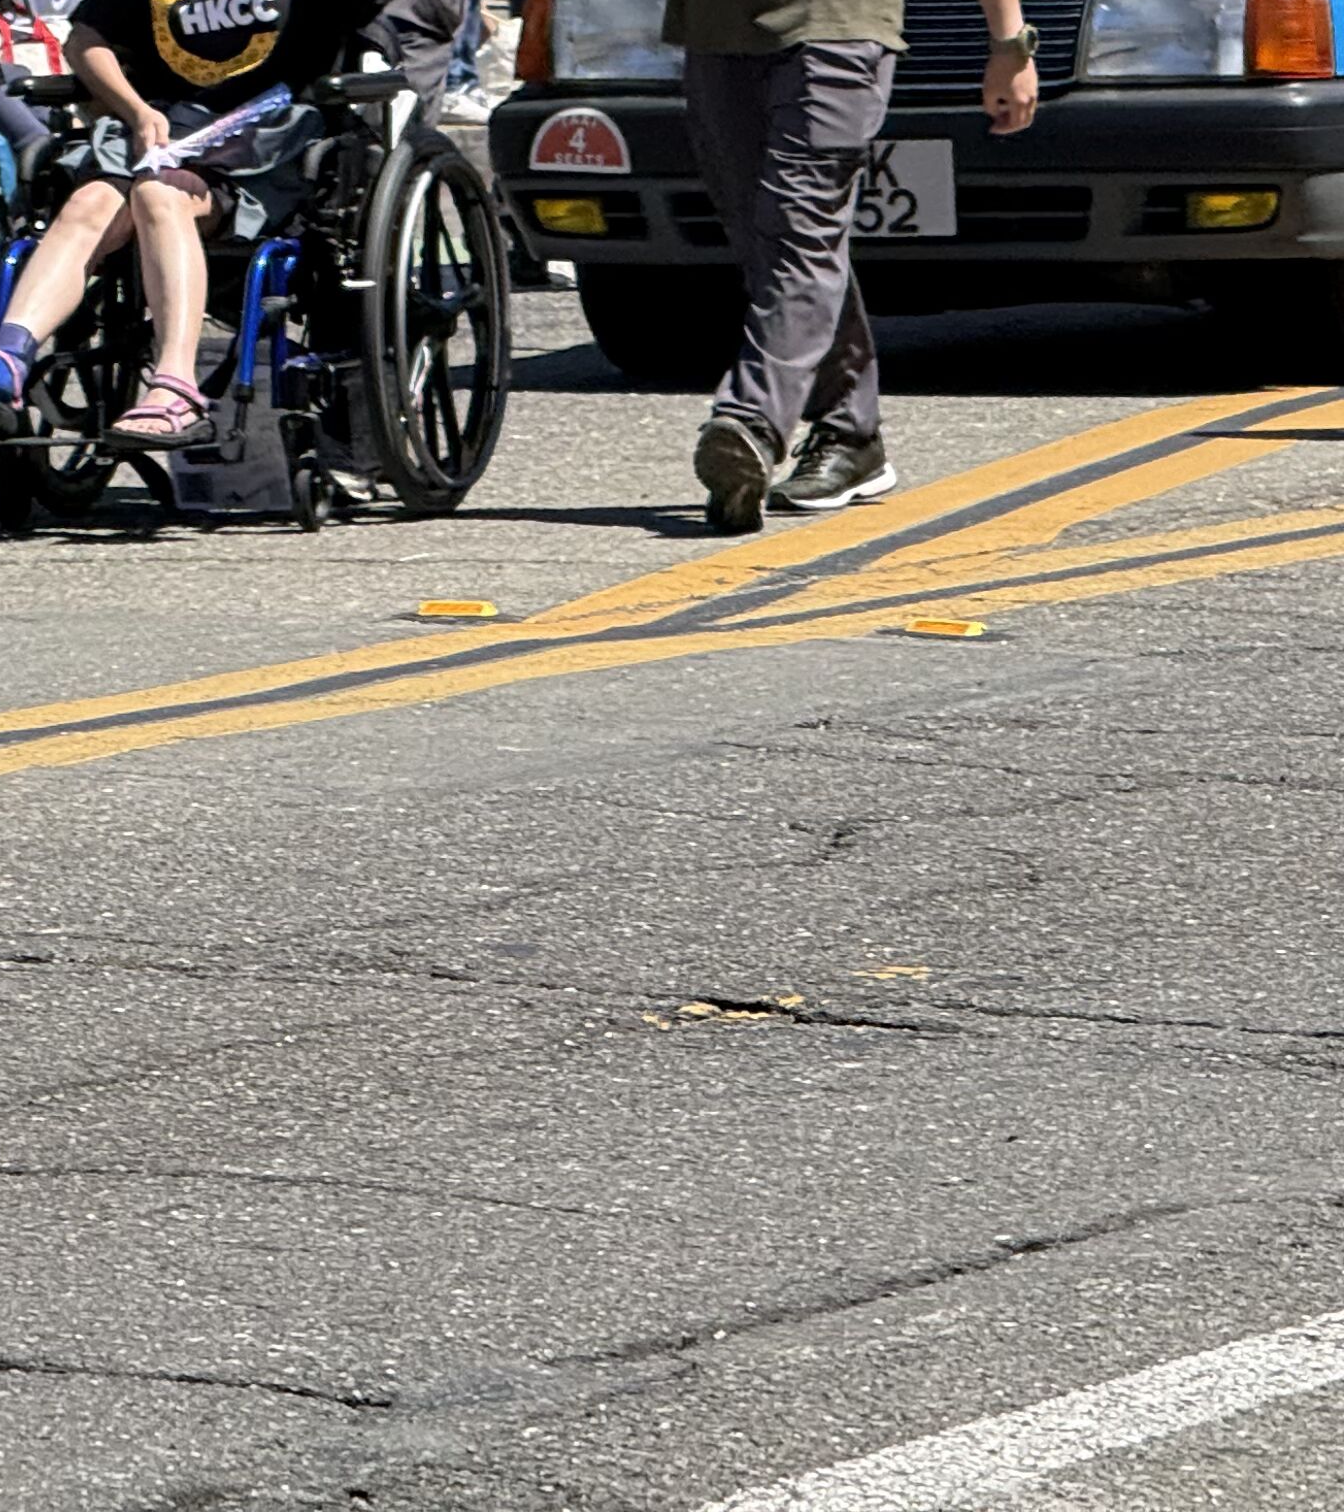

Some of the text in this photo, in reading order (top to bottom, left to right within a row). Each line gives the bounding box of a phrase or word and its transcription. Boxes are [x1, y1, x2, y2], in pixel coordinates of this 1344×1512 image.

[569, 127, 586, 154] 4
[868, 141, 898, 188] K
[853, 188, 920, 234] 52
